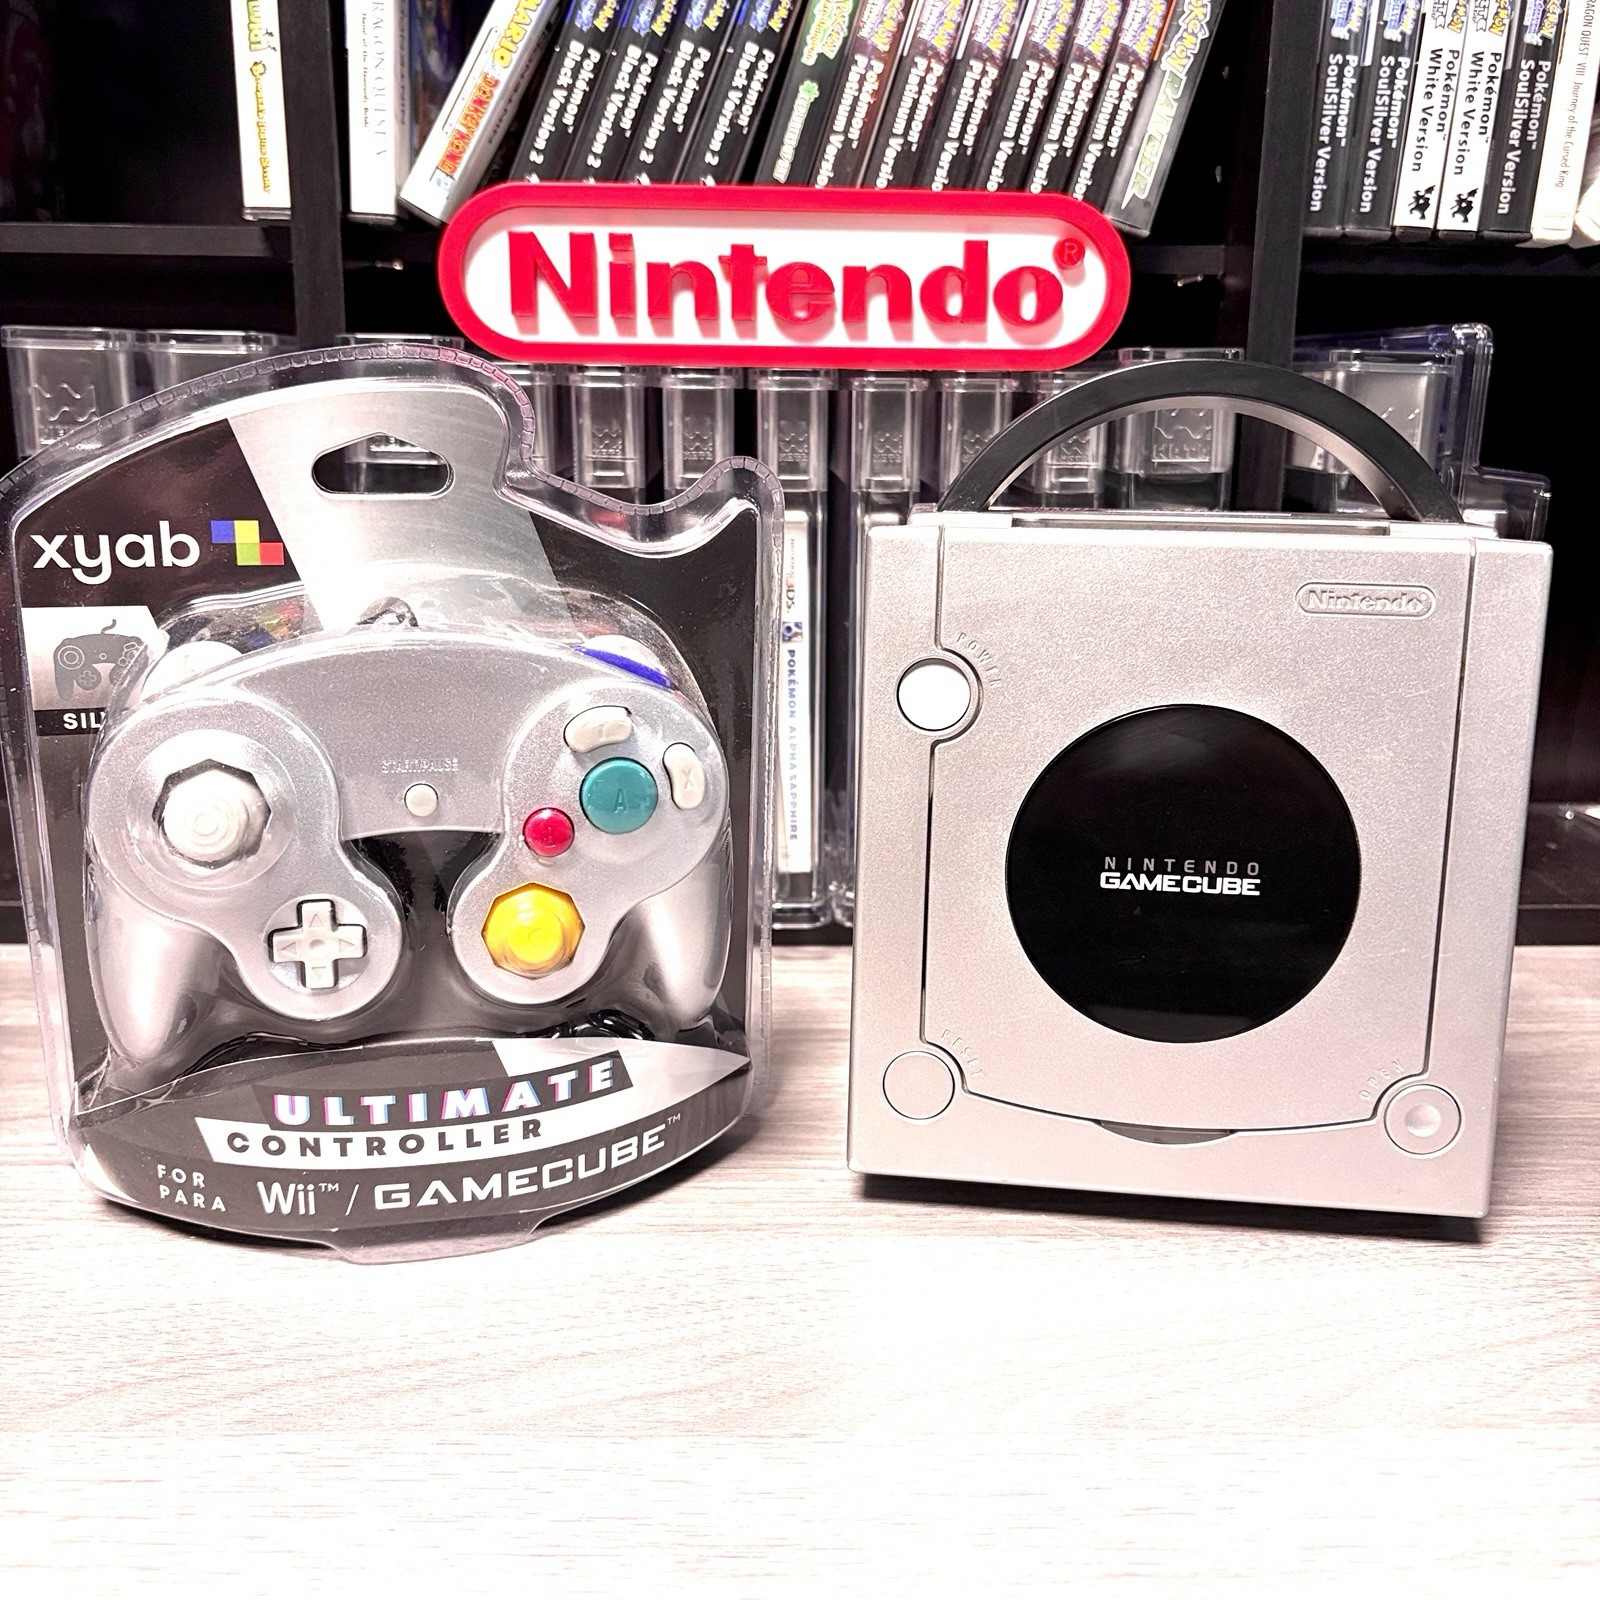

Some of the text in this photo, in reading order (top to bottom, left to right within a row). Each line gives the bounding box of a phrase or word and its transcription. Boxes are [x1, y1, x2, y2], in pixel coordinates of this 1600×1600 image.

[372, 0, 386, 71] RAGON
[1578, 30, 1592, 56] QUEST
[1582, 0, 1597, 28] RAGON
[459, 72, 500, 136] DONKEY
[530, 40, 584, 164] Black Version 2
[640, 40, 694, 163] Black Version 2
[705, 42, 759, 165] Black Version 2
[1092, 63, 1129, 140] Platinum
[1370, 56, 1395, 145] SoulSilver
[1424, 49, 1443, 99] White
[1466, 52, 1484, 102] White
[1509, 59, 1535, 147] SoulSilver
[1569, 81, 1583, 112] Journey
[587, 45, 642, 168] Black Version 2
[815, 54, 868, 189] Platinum Versio
[876, 56, 928, 189] Platinum Versio
[932, 59, 983, 192] Platinum Versio
[987, 60, 1040, 192] Platinum Versio
[1031, 62, 1088, 194] Platinum Versio
[1311, 54, 1343, 210] SoulSilver Version
[1413, 106, 1434, 171] Version
[1566, 126, 1576, 138] the
[1568, 114, 1578, 124] of
[438, 128, 468, 175] KONG
[1121, 69, 1187, 209] RANGER
[1455, 109, 1475, 174] Version
[1562, 141, 1574, 168] Cursed
[1360, 148, 1382, 212] Version
[1498, 150, 1521, 213] Version
[1555, 170, 1569, 187] King
[30, 520, 201, 585] xyab
[63, 712, 105, 730] SIL
[786, 649, 799, 841] POKÉMON ALPHA SAPPHIRE
[613, 788, 629, 814] A
[1100, 872, 1261, 896] GAMECUBE
[1104, 856, 1261, 877] NINTENDO
[273, 1058, 617, 1127] ULTIMATE
[226, 1118, 543, 1158] CONTROLLER
[156, 1164, 206, 1189] FOR
[159, 1185, 227, 1213] PARA
